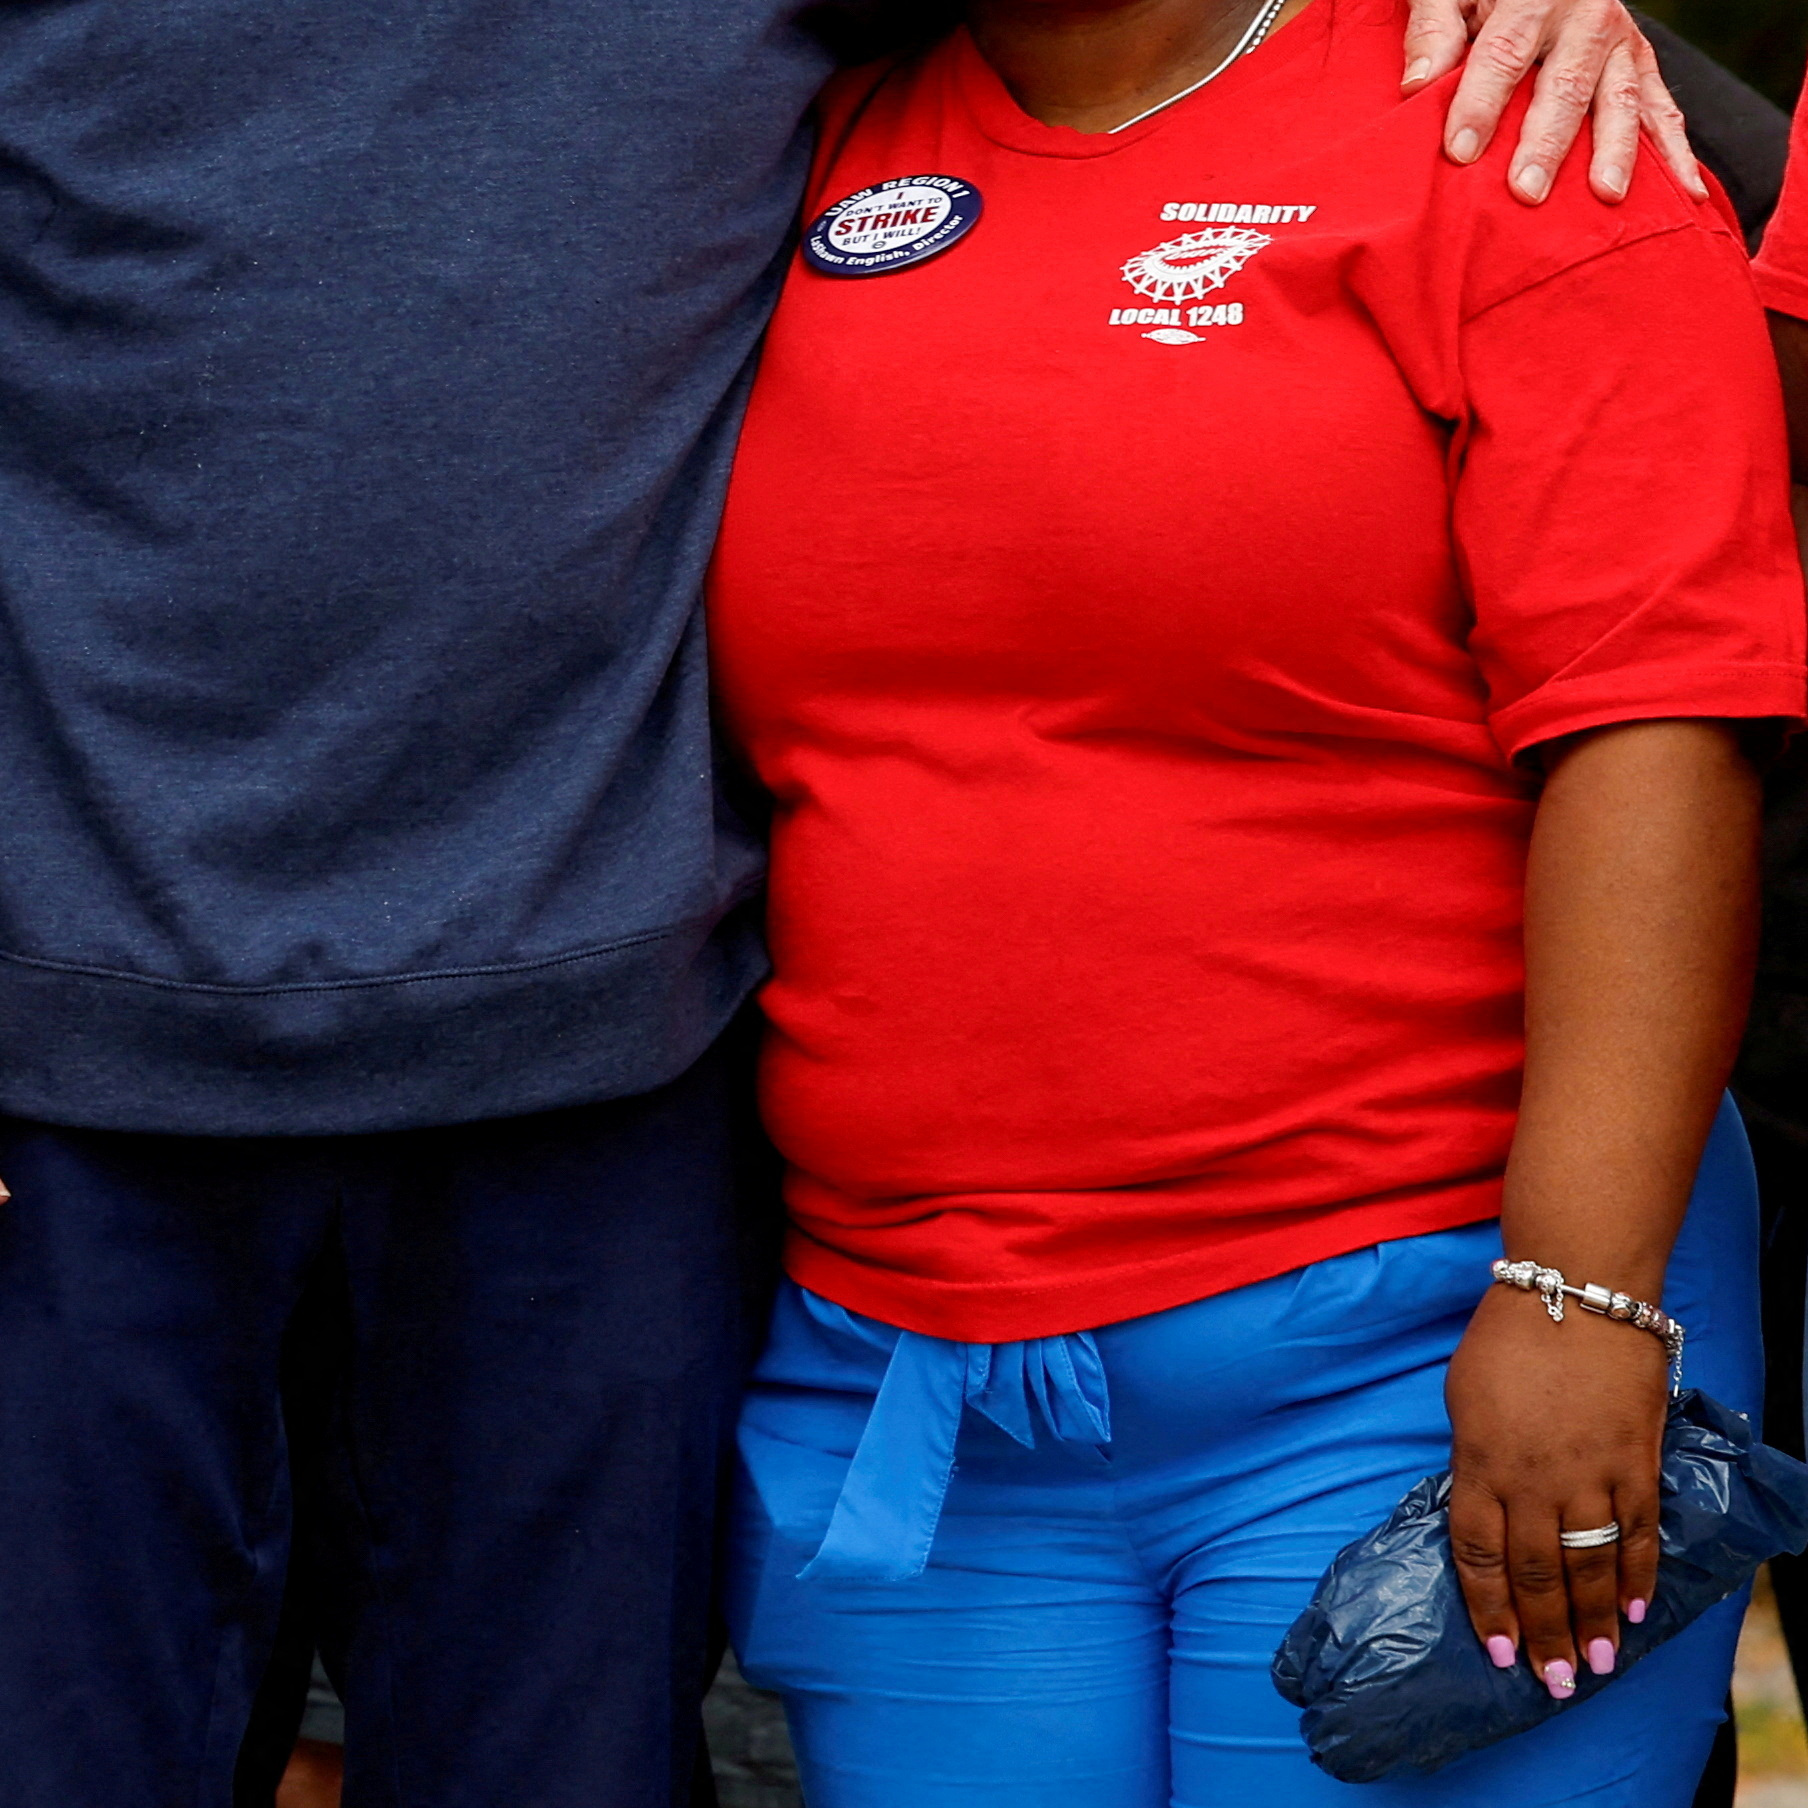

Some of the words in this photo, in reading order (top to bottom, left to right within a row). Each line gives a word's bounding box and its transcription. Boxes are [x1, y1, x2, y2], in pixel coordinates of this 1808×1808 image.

[825, 188, 873, 217] UAW
[882, 176, 965, 193] REGION
[845, 204, 884, 217] DON'T
[887, 199, 924, 210] WANT
[927, 196, 943, 204] TO
[896, 191, 904, 200] I
[834, 206, 940, 237] STRIKE
[1159, 202, 1317, 224] SOLIDARITY
[842, 234, 869, 246] BUT
[873, 233, 879, 241] I
[882, 227, 922, 239] WILL!
[845, 250, 911, 266] English,
[912, 215, 964, 251] Director
[1108, 308, 1182, 326] LOCAL
[1186, 302, 1243, 327] 1248
